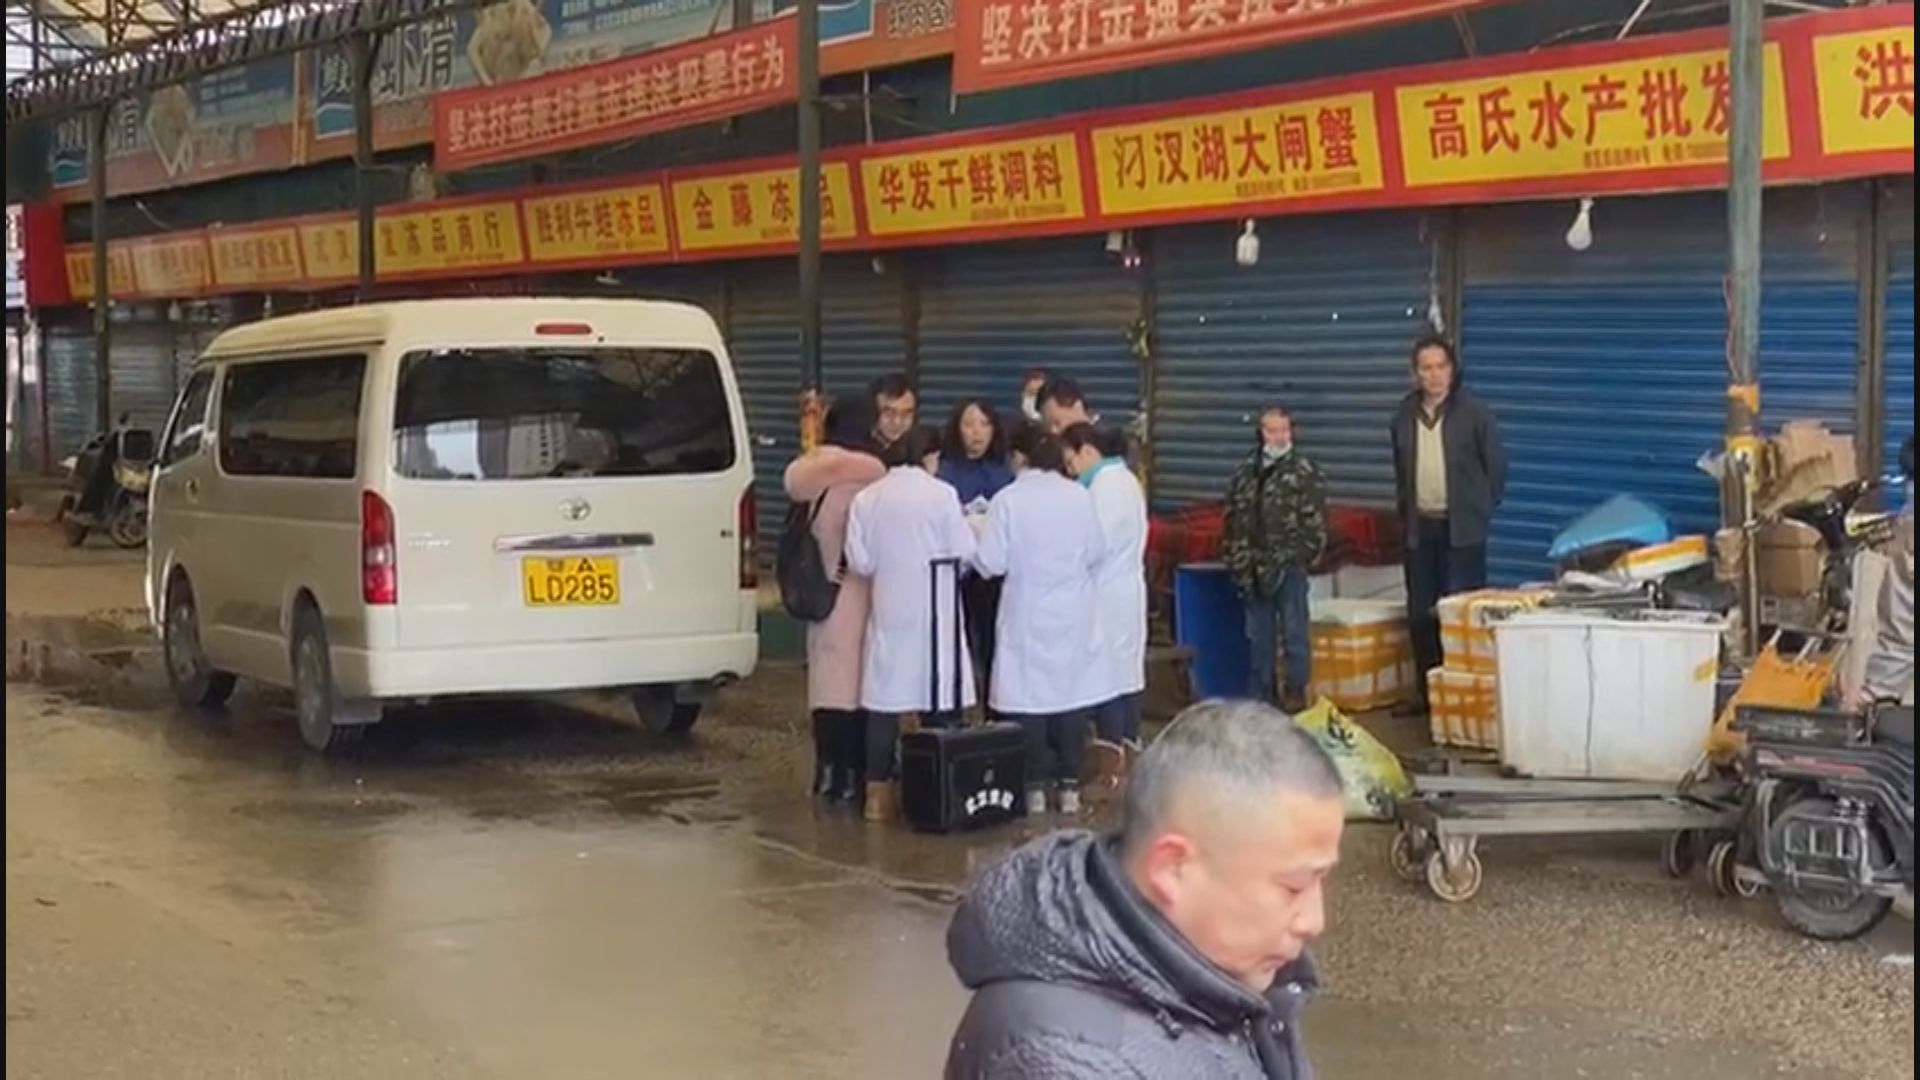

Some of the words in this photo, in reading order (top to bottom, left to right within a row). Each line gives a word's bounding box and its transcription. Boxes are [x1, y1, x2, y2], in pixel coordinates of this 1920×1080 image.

[879, 143, 1063, 214] 华发干鲜调料
[528, 574, 614, 603] LD285
